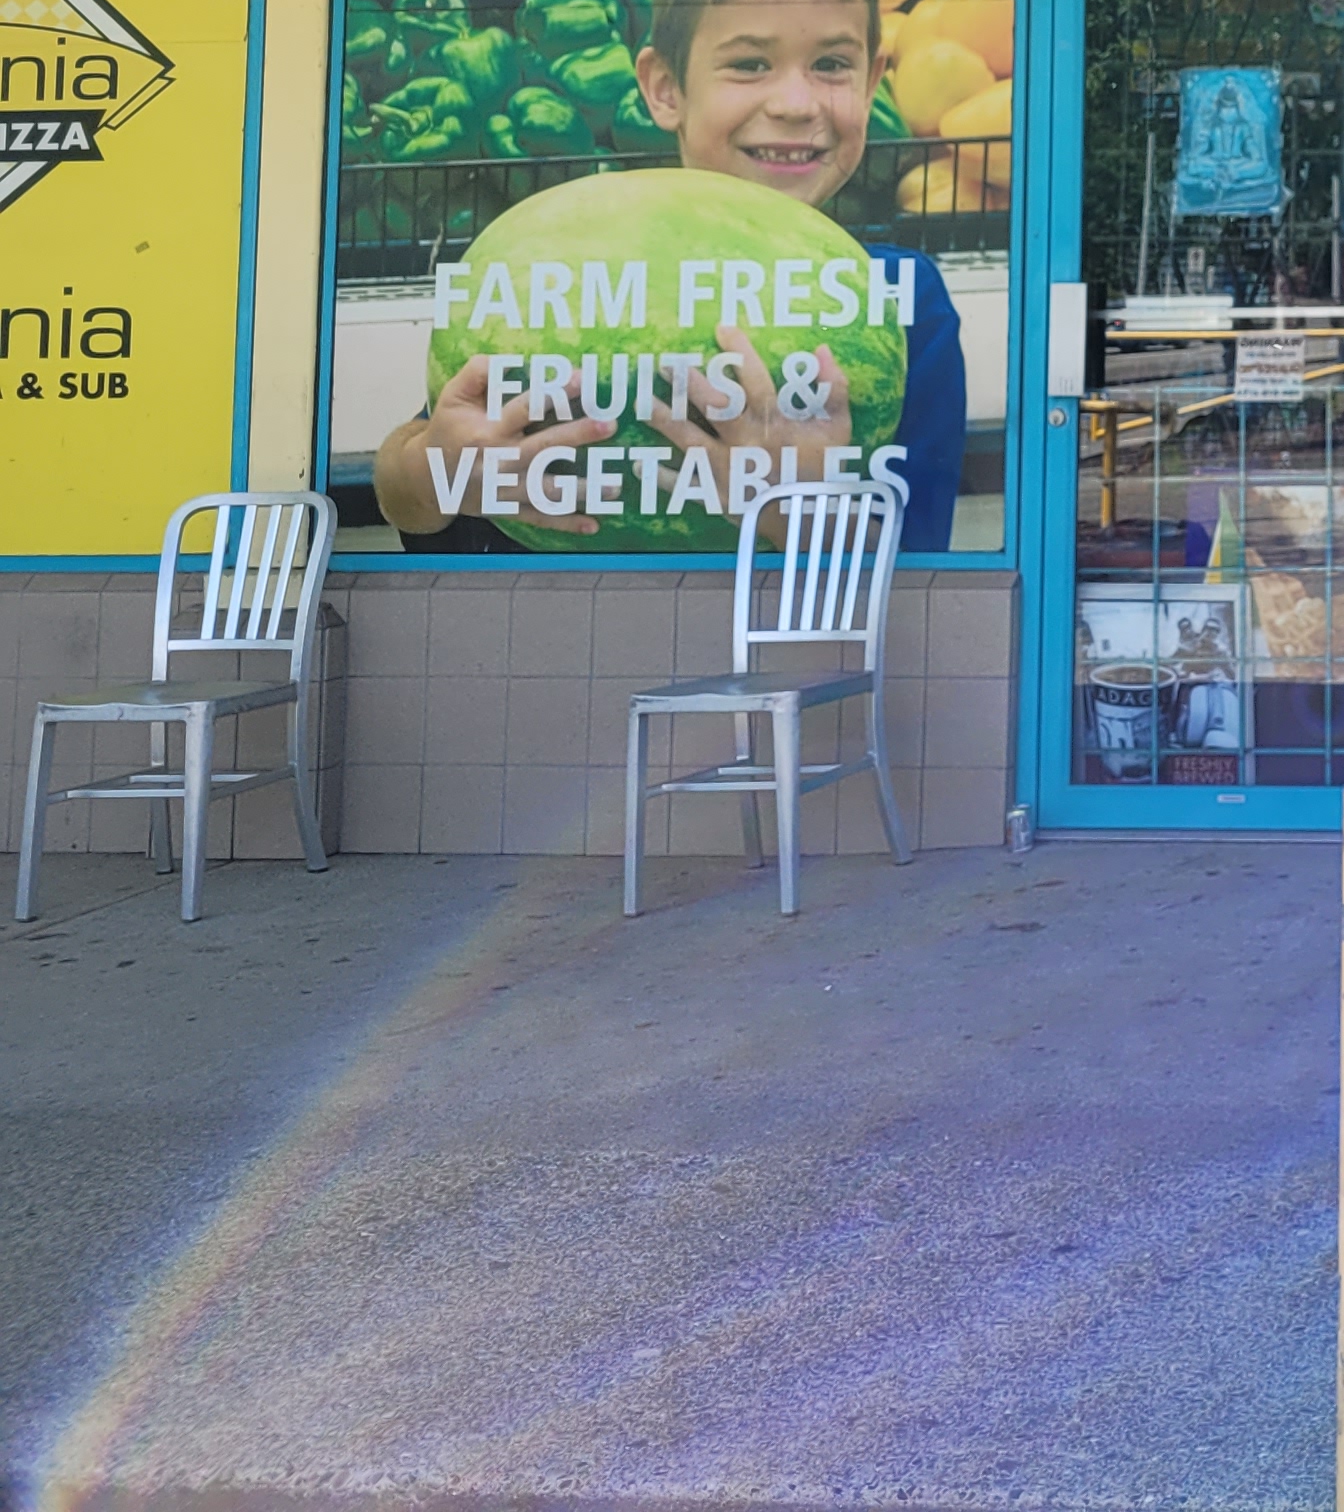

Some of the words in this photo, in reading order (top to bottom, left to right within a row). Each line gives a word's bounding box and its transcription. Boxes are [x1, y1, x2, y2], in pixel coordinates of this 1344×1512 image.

[433, 261, 647, 330] FARM
[678, 257, 916, 328] FRESH
[58, 372, 130, 400] SUB
[486, 351, 744, 423] FRUITS
[776, 349, 831, 422] &
[1174, 757, 1235, 771] FRESHLY
